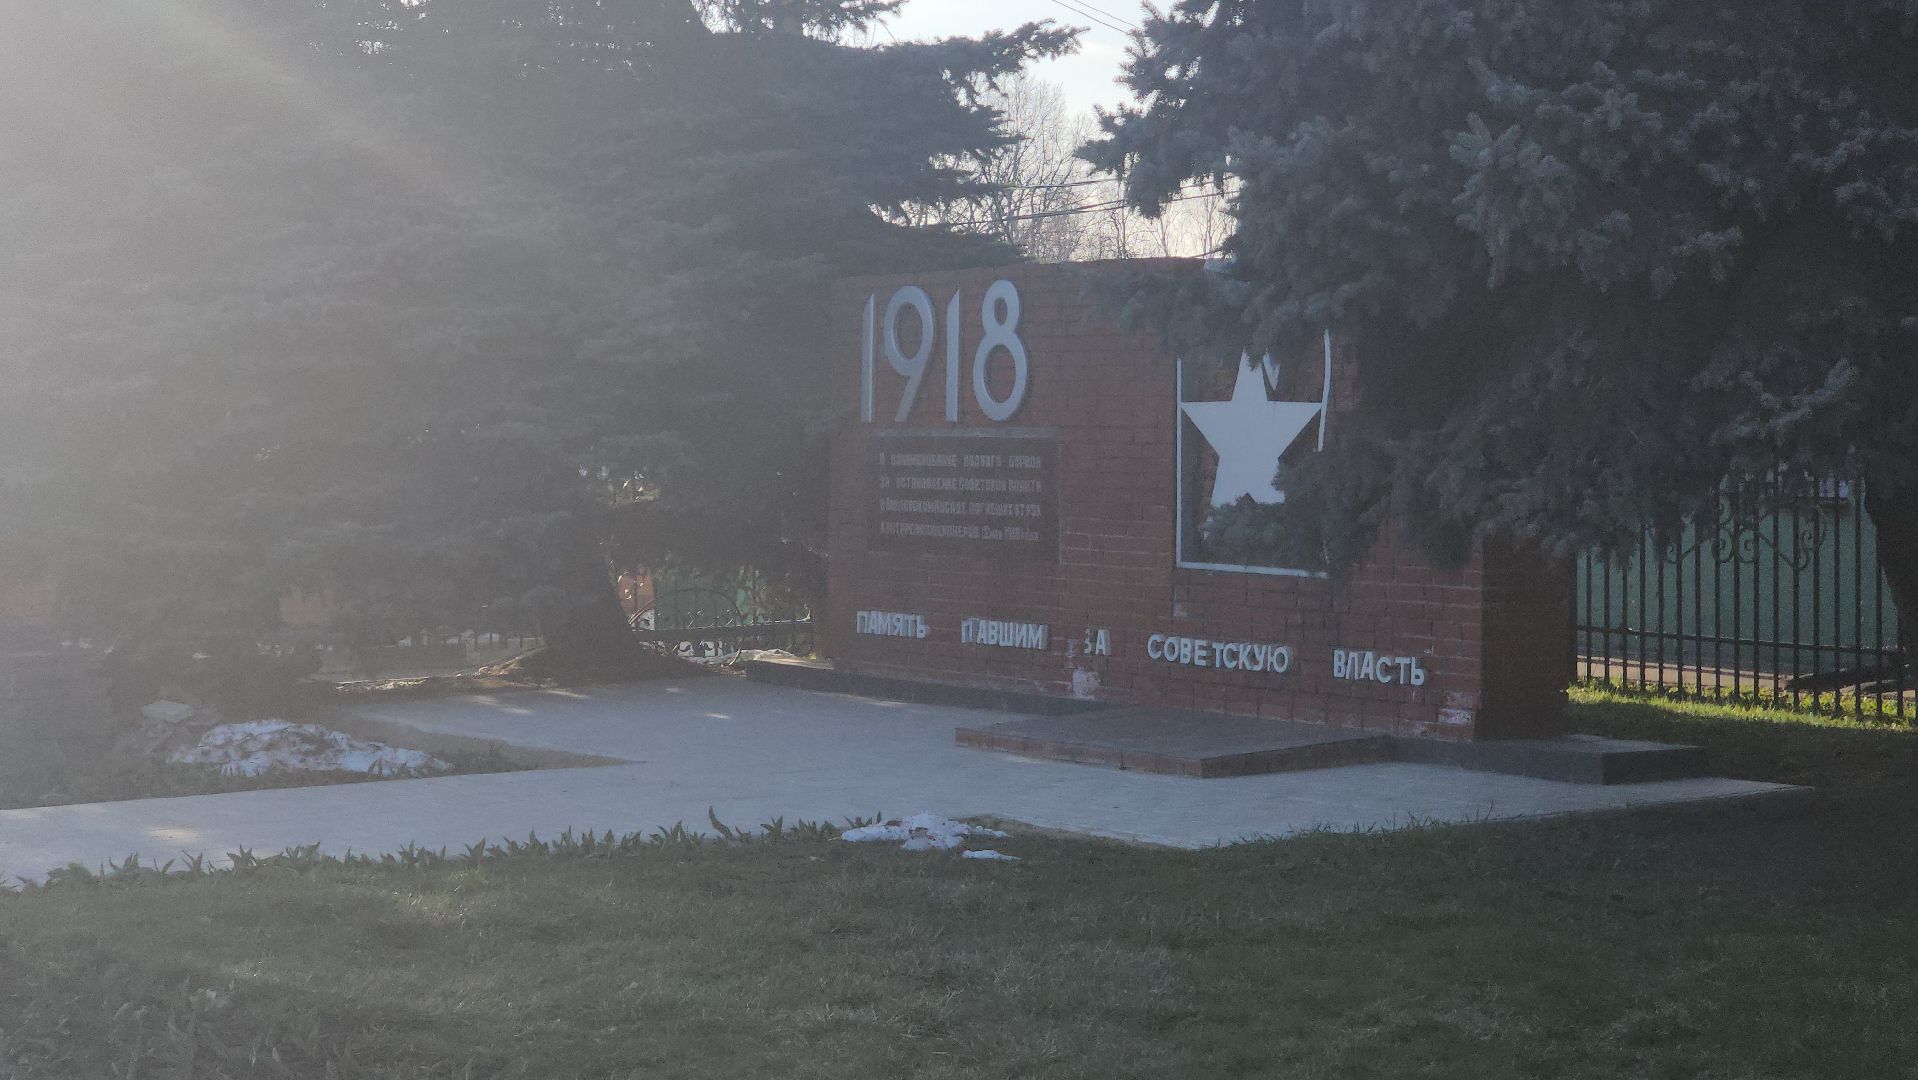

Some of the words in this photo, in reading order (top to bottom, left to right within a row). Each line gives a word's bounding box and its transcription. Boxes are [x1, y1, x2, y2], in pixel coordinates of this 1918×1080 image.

[861, 279, 1028, 423] 1918
[856, 611, 928, 639] ПАМЯТЬ
[961, 617, 1046, 650] ПАВШИМ
[1147, 633, 1292, 673] СОВЕТСКУЮ
[1333, 649, 1425, 686] ВЛАСТЬ
